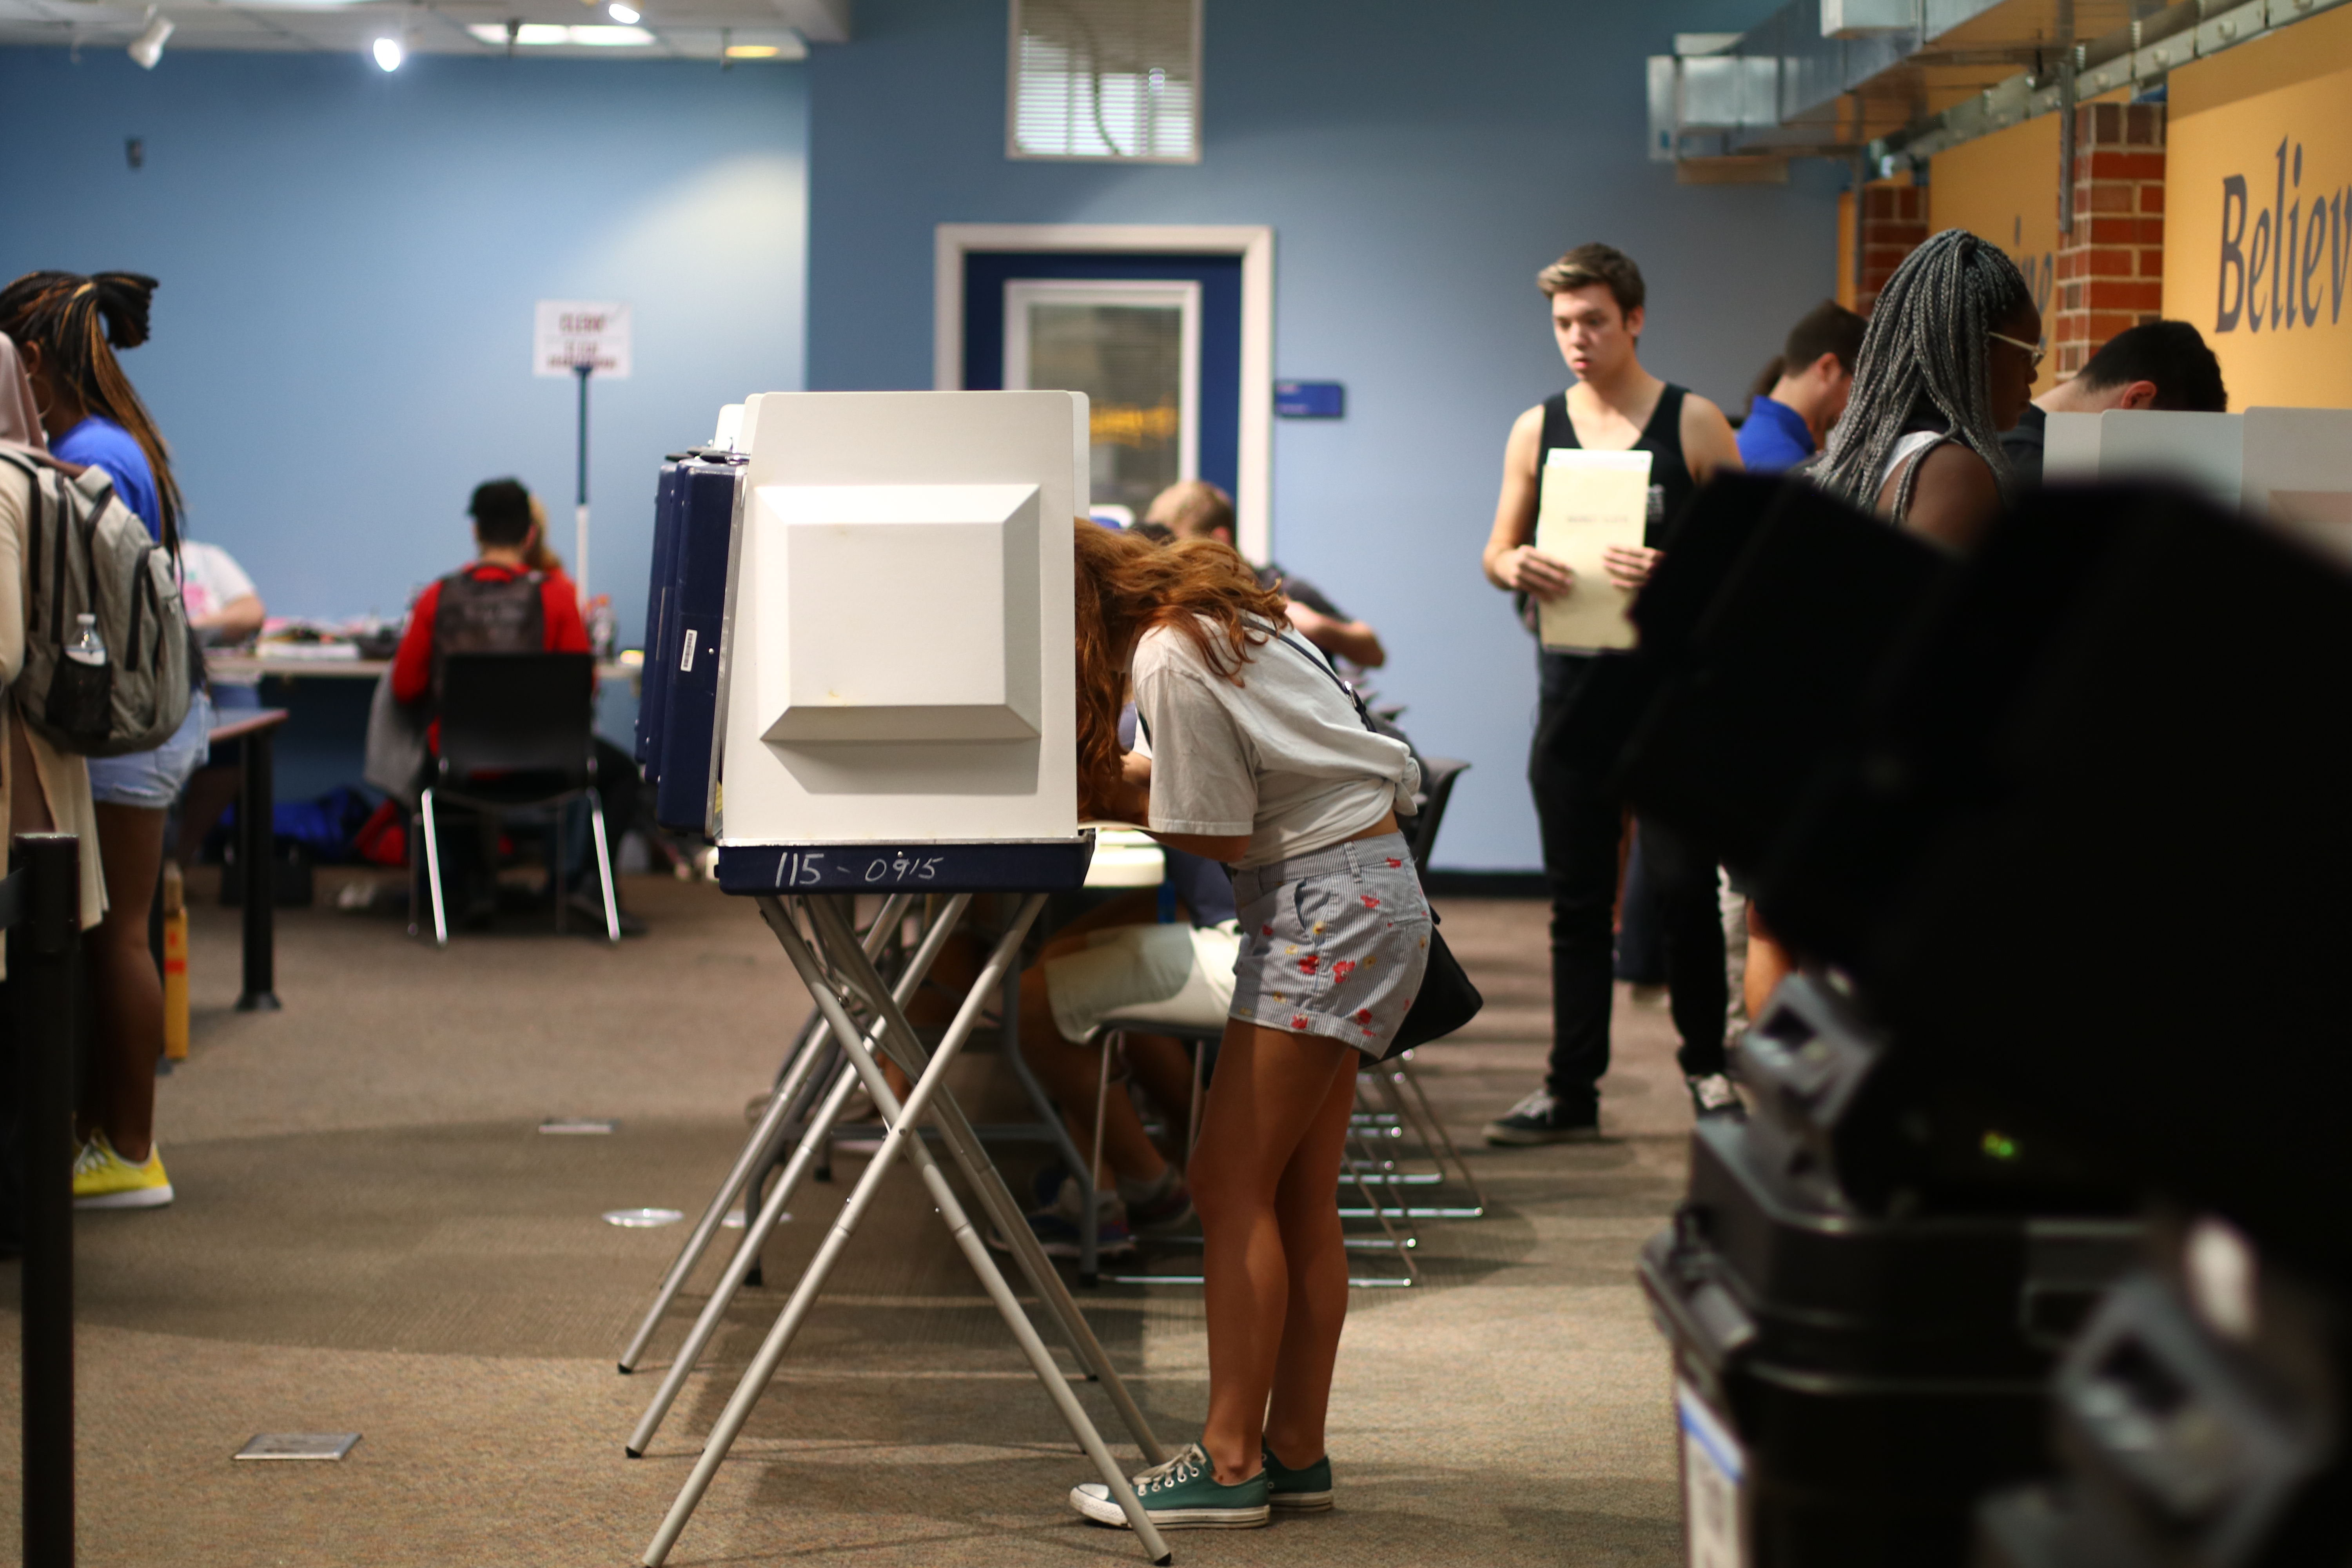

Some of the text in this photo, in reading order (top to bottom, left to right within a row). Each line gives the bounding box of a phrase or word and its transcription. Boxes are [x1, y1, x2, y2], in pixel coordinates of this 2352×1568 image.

[2216, 134, 2352, 333] Believ
[775, 852, 824, 888] 115
[864, 857, 944, 882] 0915
